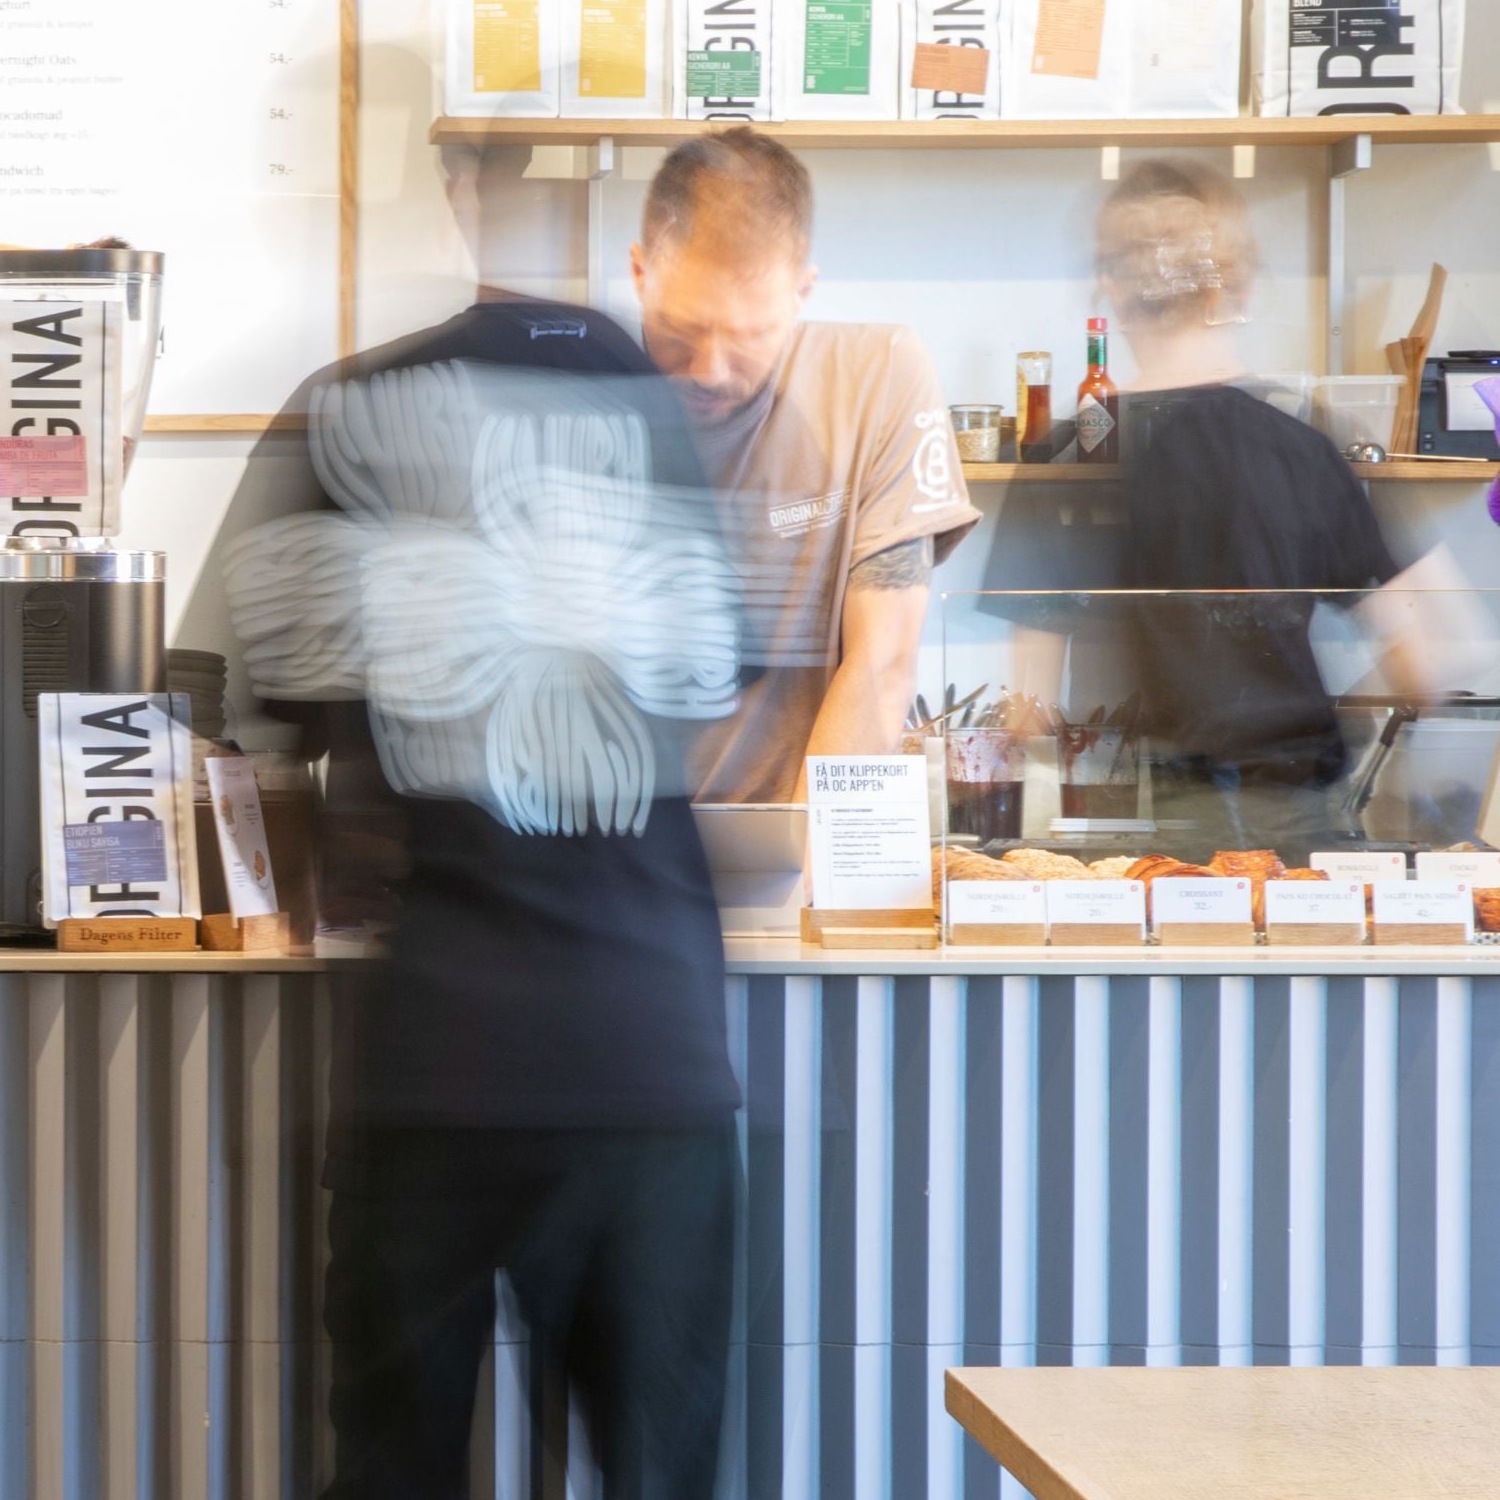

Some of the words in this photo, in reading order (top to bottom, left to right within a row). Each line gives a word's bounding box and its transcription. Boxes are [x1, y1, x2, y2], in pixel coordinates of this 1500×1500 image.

[268, 52, 293, 64] 54.-
[268, 108, 294, 120] 54.-
[267, 164, 294, 176] 79.-
[816, 762, 828, 777] FÅ
[831, 765, 846, 777] DIT
[849, 764, 909, 777] KLIPPEKORT
[816, 777, 830, 791] PÅ
[832, 780, 847, 791] OC
[65, 825, 103, 838] ETIOPIEN
[66, 838, 90, 849] BUKU
[79, 927, 134, 945] Dagens
[139, 927, 183, 941] Filter
